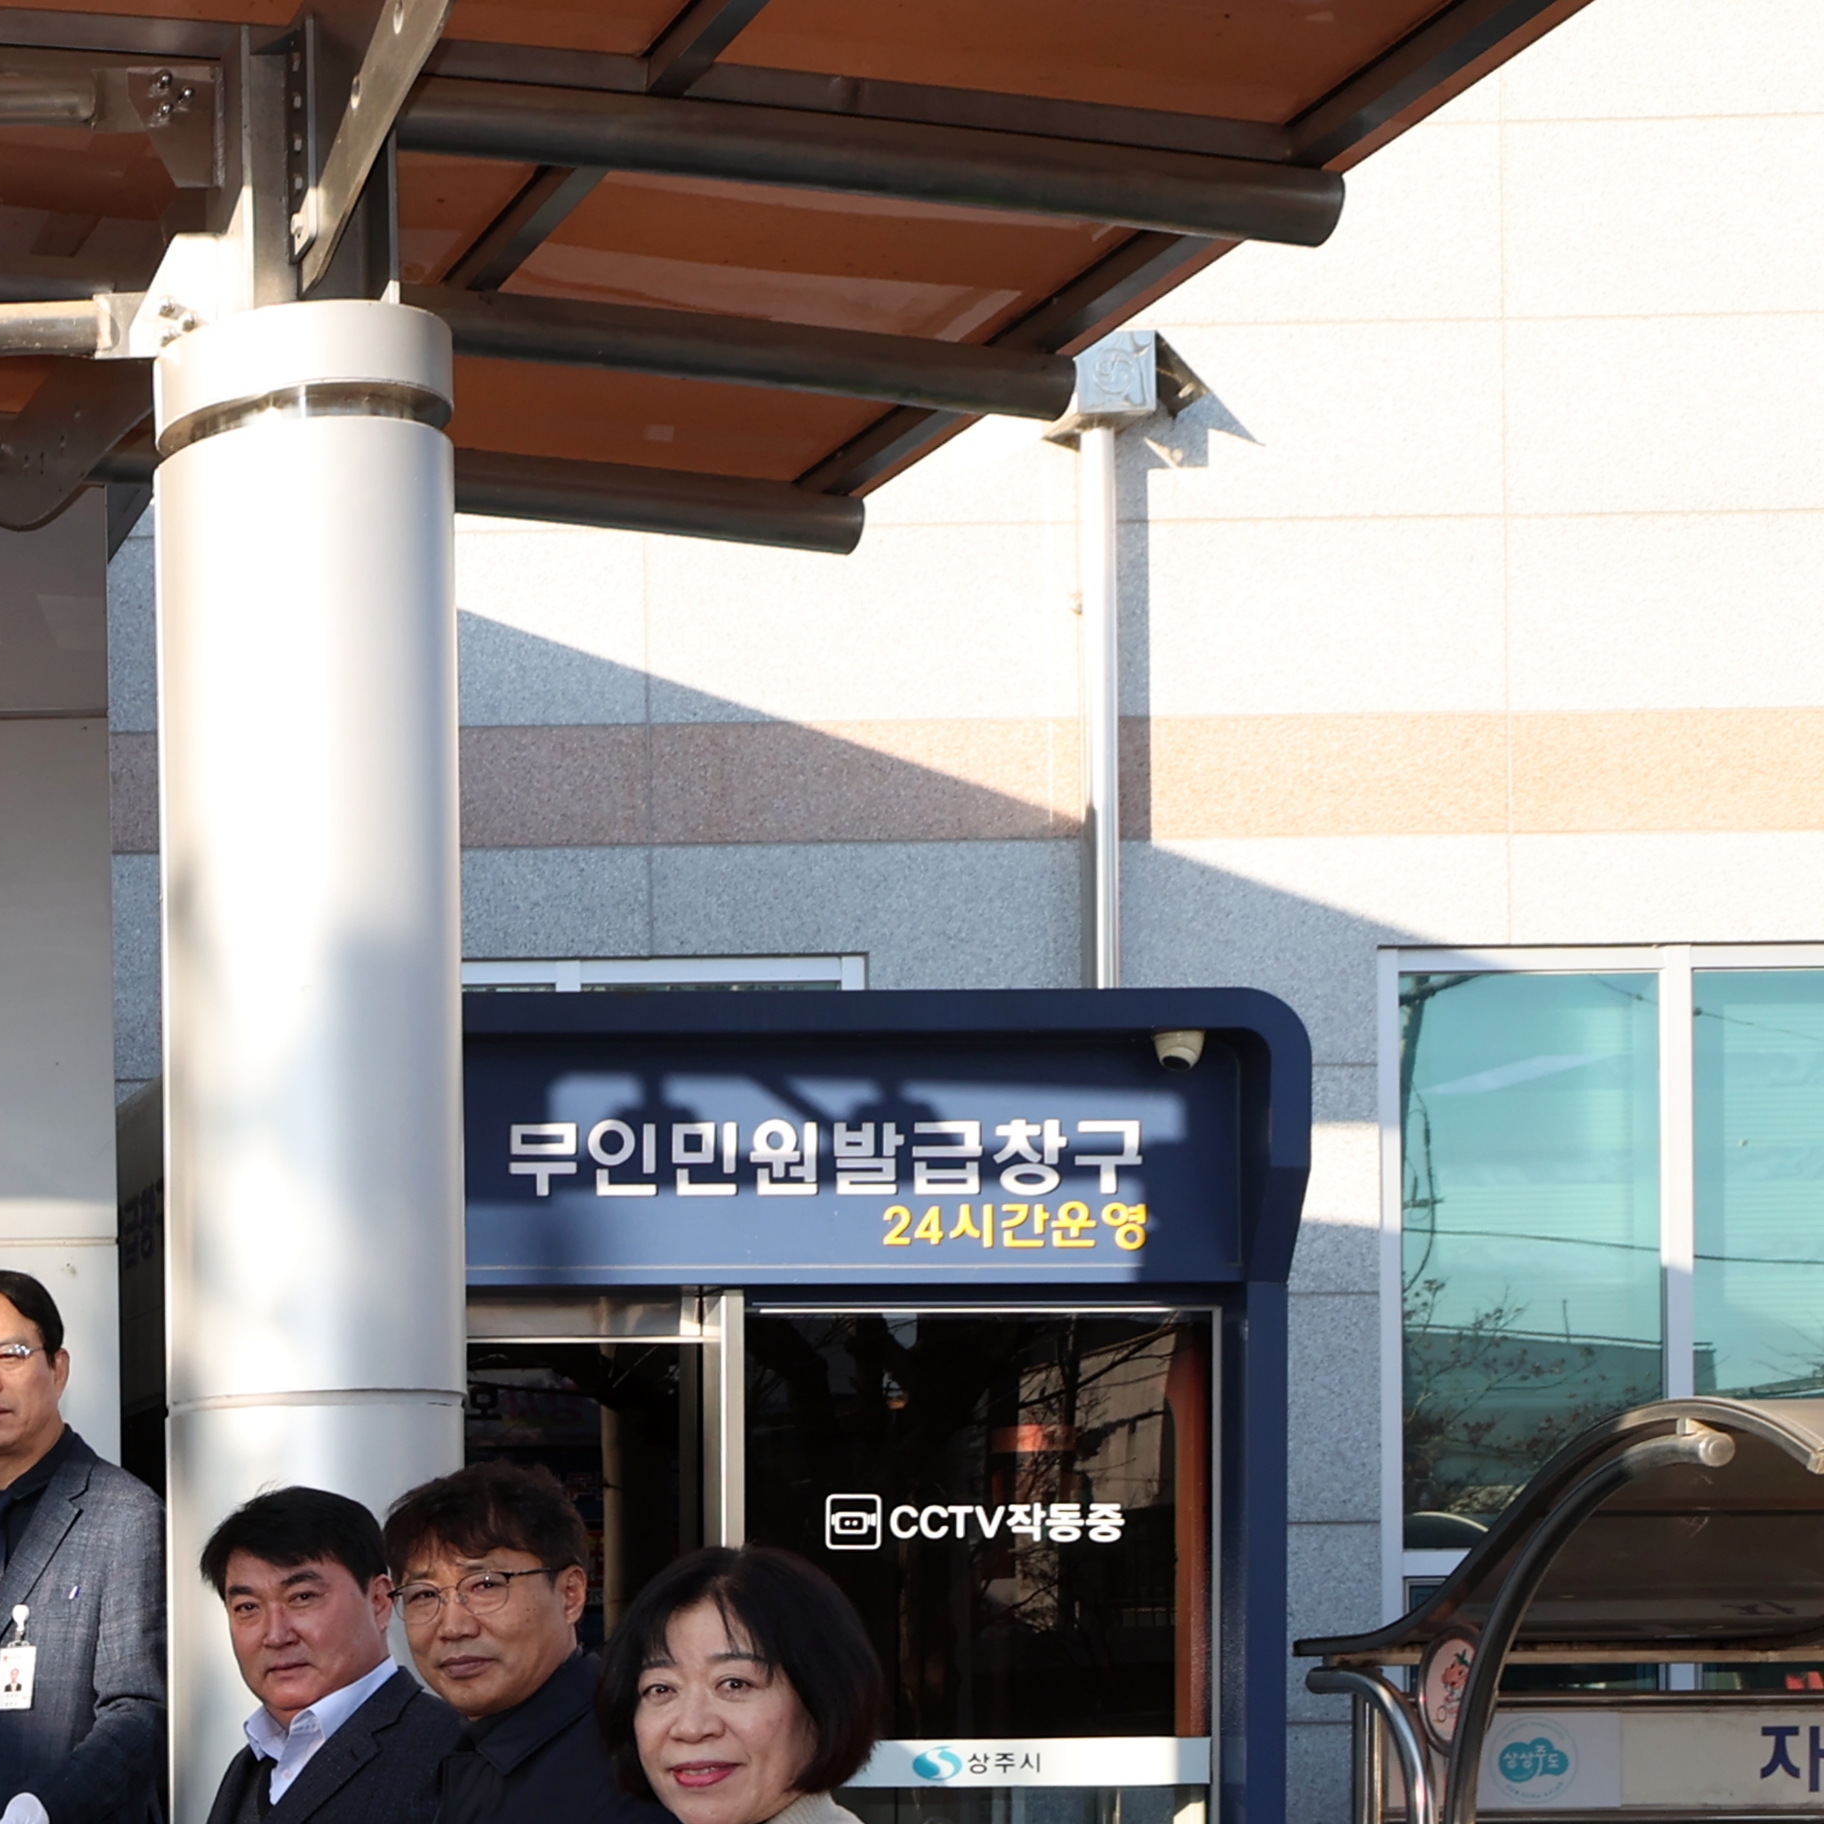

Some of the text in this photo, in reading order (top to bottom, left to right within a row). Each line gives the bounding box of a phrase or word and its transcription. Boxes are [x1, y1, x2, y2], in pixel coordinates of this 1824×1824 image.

[508, 1118, 1146, 1198] 무인민원발급창구
[882, 1201, 1148, 1251] 24시간운영
[889, 1500, 1126, 1545] CCTV작동중
[967, 1751, 1043, 1776] 상주시
